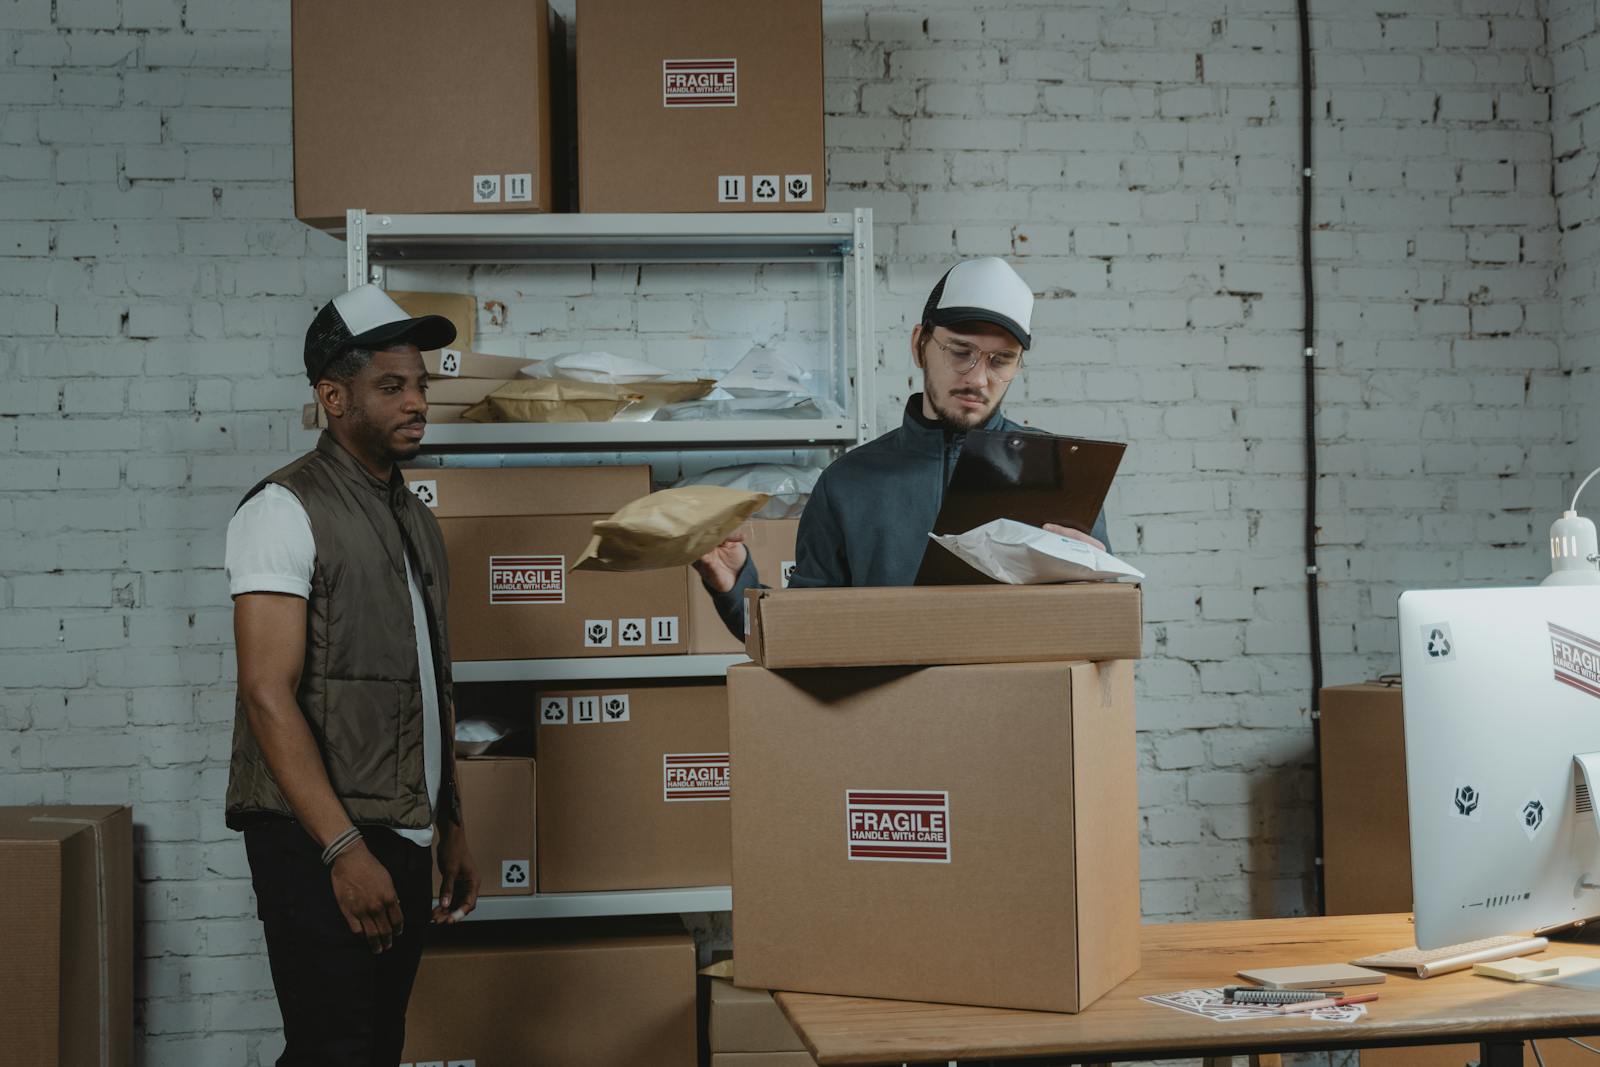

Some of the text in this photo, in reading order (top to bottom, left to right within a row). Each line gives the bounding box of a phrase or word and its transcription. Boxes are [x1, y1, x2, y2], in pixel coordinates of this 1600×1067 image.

[667, 73, 733, 87] FRAGILE
[493, 571, 561, 584] FRAGILE
[1553, 640, 1600, 673] FRAGIL
[851, 812, 944, 832] FRAGILE
[852, 831, 944, 842] HANDLE WITH CARE
